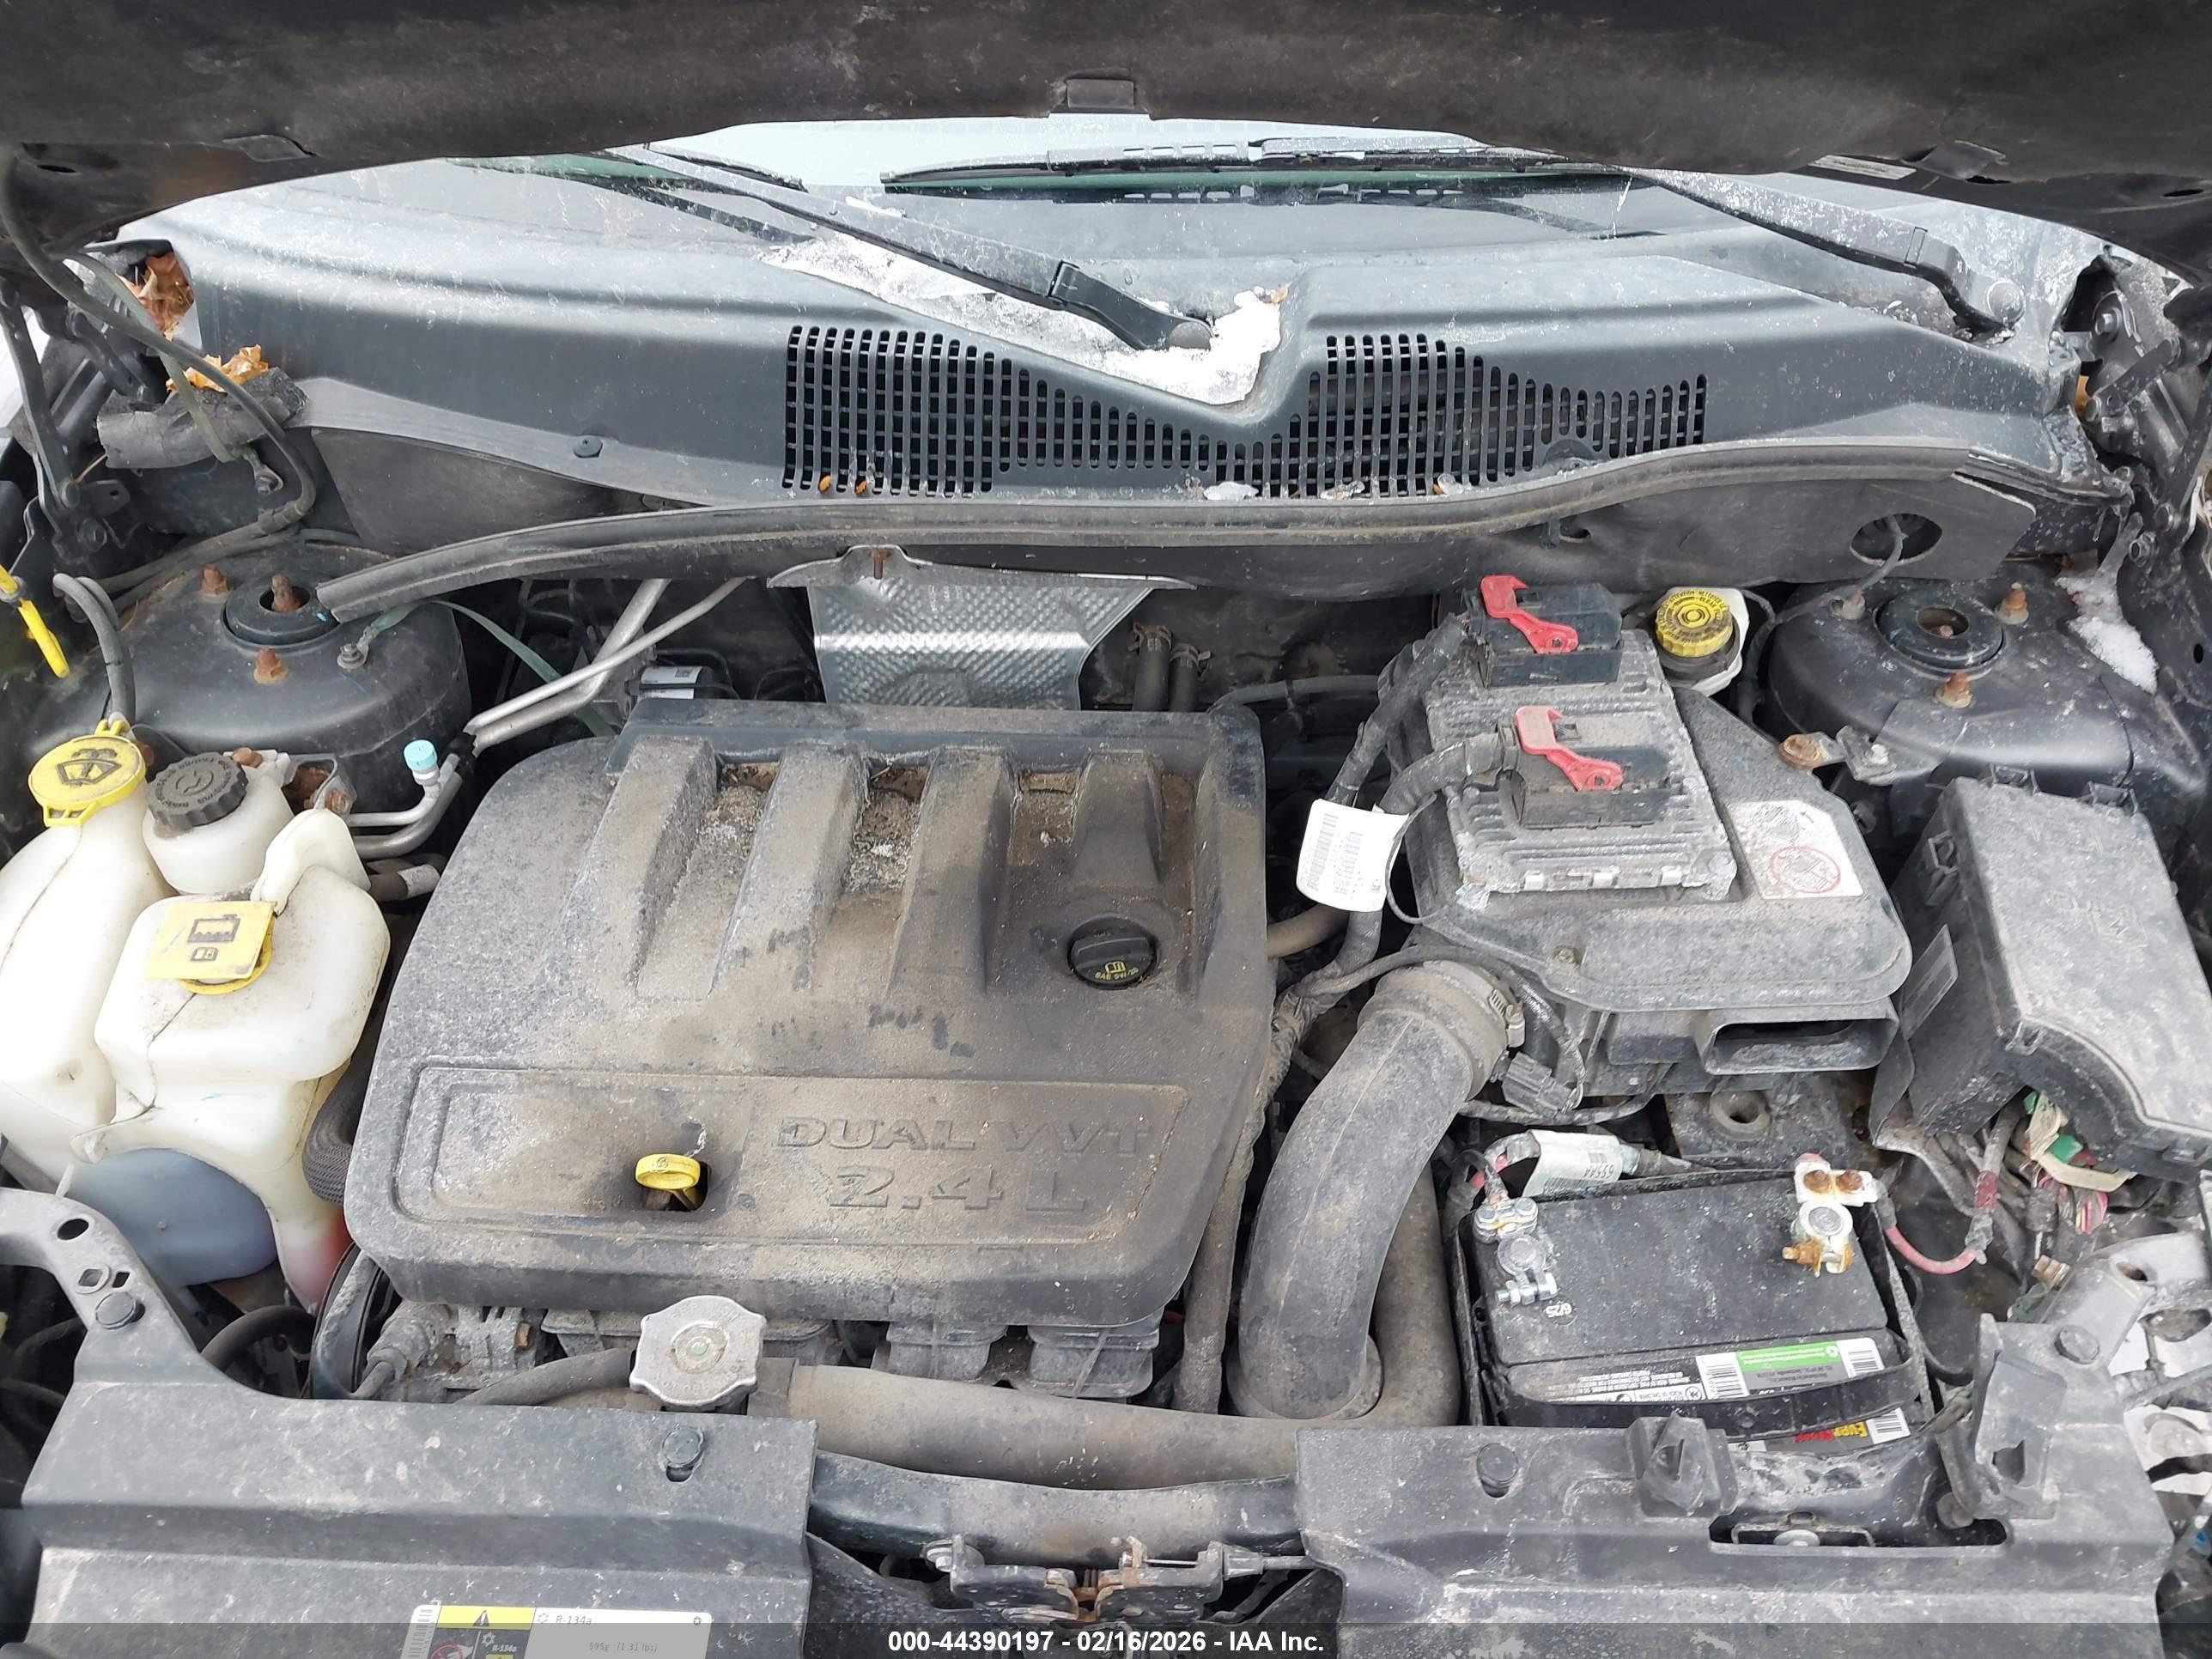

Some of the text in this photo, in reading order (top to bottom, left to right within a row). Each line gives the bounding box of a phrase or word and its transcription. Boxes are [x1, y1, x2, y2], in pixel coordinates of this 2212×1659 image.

[775, 1118, 1152, 1158] DUAL VVT
[1545, 1302, 1572, 1318] 6/25
[555, 1614, 592, 1626] R-134a
